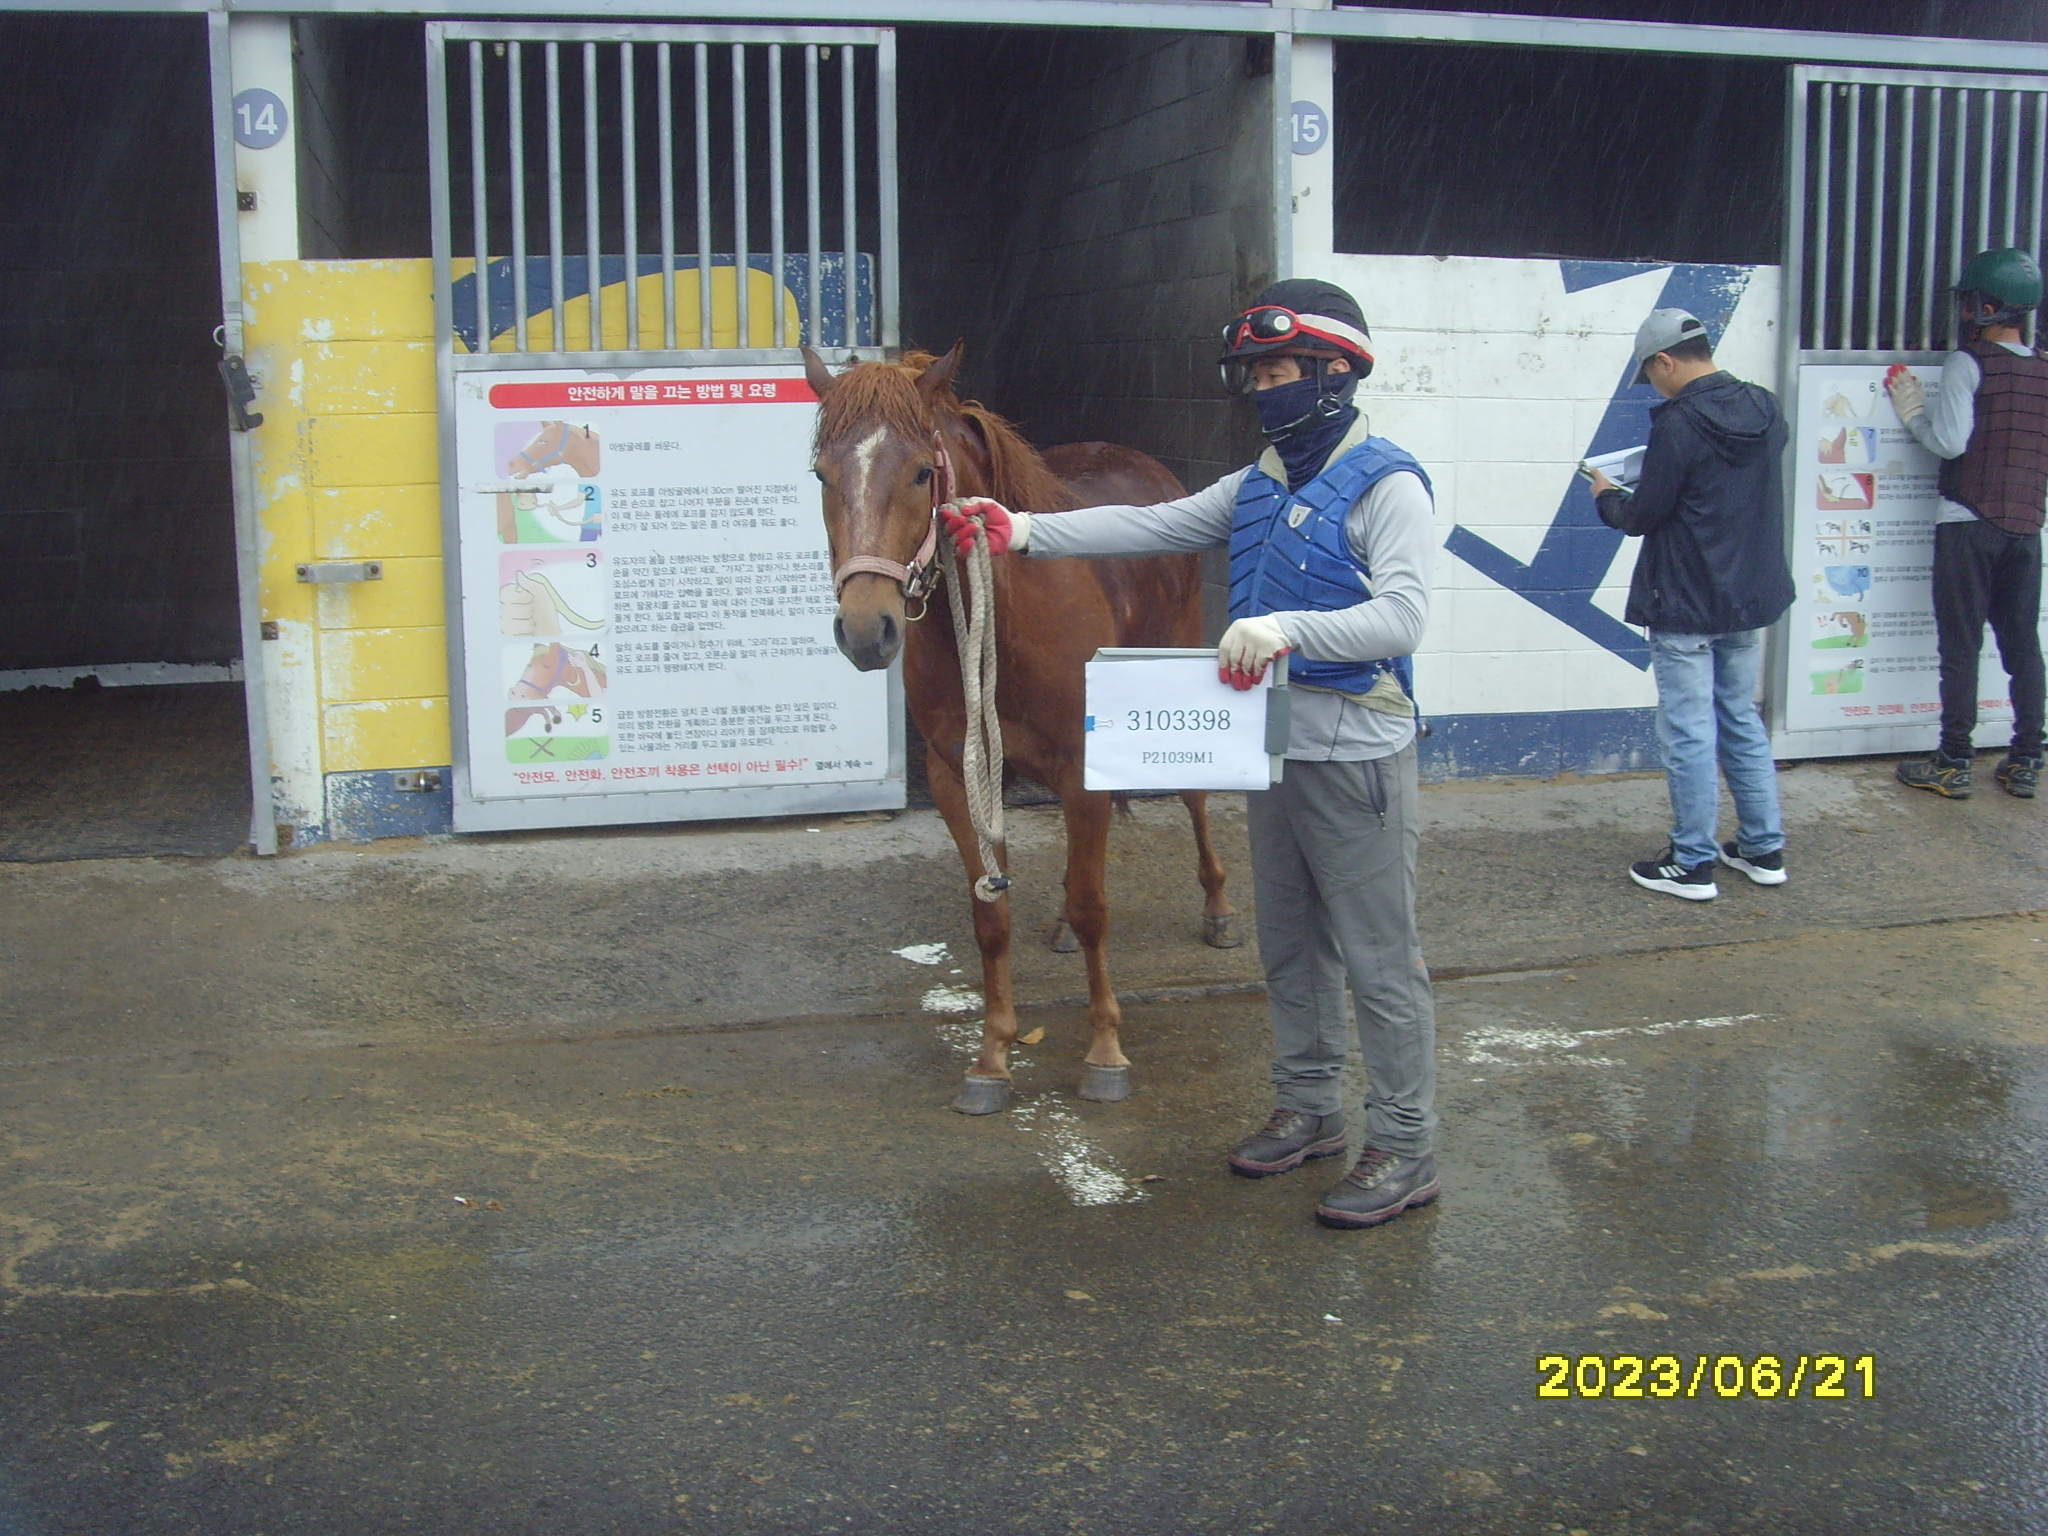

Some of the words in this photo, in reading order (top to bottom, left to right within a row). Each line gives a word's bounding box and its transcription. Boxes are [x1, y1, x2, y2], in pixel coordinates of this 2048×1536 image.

[237, 103, 278, 135] 14
[1290, 113, 1320, 143] 15
[567, 385, 624, 401] 안전하게
[629, 384, 658, 400] 말을
[662, 385, 691, 399] 끄는
[696, 383, 724, 398] 방법
[729, 383, 743, 397] 및
[748, 383, 776, 398] 요령
[1869, 382, 1876, 392] 6
[582, 424, 590, 438] 1
[1868, 428, 1874, 439] 7
[608, 441, 651, 451] 마방굴레를
[1866, 475, 1872, 485] 8
[584, 486, 595, 500] 2
[610, 488, 627, 497] 유도
[630, 487, 655, 496] 로프를
[658, 486, 708, 496] 마방굴레에서
[710, 486, 734, 494] 30cm
[736, 485, 762, 494] 떨어진
[764, 484, 796, 493] 지점에서
[610, 499, 627, 509] 오른
[630, 499, 655, 508] 손으로
[658, 498, 675, 507] 잡고
[705, 496, 730, 506] 부분을
[734, 496, 759, 505] 왼손에
[761, 496, 778, 504] 모아
[610, 511, 620, 519] 이
[622, 511, 631, 520] 때
[634, 510, 650, 519] 왼손
[681, 508, 706, 518] 로프를
[709, 508, 726, 517] 감지
[728, 507, 754, 517] 않도록
[756, 506, 775, 516] 한다.
[610, 522, 637, 531] 순치가
[639, 522, 648, 531] 잘
[650, 521, 668, 530] 되어
[670, 521, 687, 529] 있는
[689, 519, 707, 529] 말은
[720, 519, 729, 528] 더
[732, 518, 757, 528] 여유를
[586, 552, 597, 568] 3
[612, 556, 645, 565] 유도자의
[668, 554, 709, 564] 진행하려는
[712, 553, 745, 562] 방향으로
[748, 552, 773, 561] 향하고
[776, 551, 792, 560] 유도
[795, 550, 819, 559] 로프를
[612, 567, 629, 577] 손을
[631, 567, 649, 576] 약간
[756, 562, 789, 572] 말하거나
[1857, 568, 1868, 578] 10
[612, 578, 655, 588] 조심스럽게
[657, 578, 674, 587] 걷기
[715, 575, 732, 585] 말이
[734, 575, 751, 584] 따라
[754, 574, 771, 584] 걷기
[773, 573, 806, 583] 시작하면
[613, 590, 638, 599] 로프에
[641, 589, 674, 598] 가해지는
[705, 587, 732, 596] 줄인다.
[734, 586, 752, 595] 말이
[754, 584, 787, 594] 유도자를
[789, 584, 806, 593] 끌고
[699, 599, 708, 608] 말
[710, 598, 727, 607] 목에
[730, 597, 747, 606] 대어
[749, 596, 774, 606] 간격을
[776, 595, 802, 605] 유지한
[804, 595, 821, 603] 채로
[633, 612, 653, 621] 한다.
[683, 610, 708, 619] 때마다
[787, 607, 804, 616] 말이
[614, 624, 647, 634] 잡으려고
[650, 623, 666, 632] 하는
[588, 644, 600, 658] 4
[614, 642, 632, 652] 말의
[634, 641, 659, 651] 속도를
[662, 640, 696, 650] 줄이거나
[697, 639, 723, 649] 멈추기
[615, 653, 632, 662] 유도
[635, 652, 659, 662] 로프를
[662, 652, 679, 661] 줄여
[704, 649, 736, 660] 오른손을
[739, 649, 756, 658] 말의
[770, 647, 802, 657] 근처까지
[615, 665, 632, 674] 유도
[635, 664, 660, 673] 로프가
[706, 661, 726, 670] 한다.
[592, 708, 602, 722] 5
[616, 710, 634, 719] 급한
[636, 708, 678, 718] 방향전환은
[680, 707, 697, 716] 덩치
[700, 706, 708, 715] 큰
[730, 704, 771, 714] 동물에게는
[811, 701, 839, 710] 일이다.
[617, 721, 634, 730] 미리
[636, 720, 654, 730] 방향
[656, 718, 681, 728] 전환을
[747, 714, 771, 725] 공간을
[774, 714, 791, 723] 두고
[793, 713, 810, 722] 크게
[1126, 710, 1231, 731] 3103398
[618, 732, 635, 742] 또한
[637, 731, 662, 740] 바닥에
[747, 726, 756, 736] 등
[618, 743, 635, 752] 있는
[637, 741, 670, 752] 사물과는
[673, 740, 698, 750] 거리를
[700, 739, 718, 748] 두고
[720, 738, 736, 748] 말을
[739, 736, 774, 747] 유도한다.
[815, 760, 840, 770] 옆에서
[844, 759, 860, 768] 계속
[1142, 752, 1214, 764] P21039M1
[610, 765, 659, 779] 안전조끼
[664, 763, 701, 777] 착용은
[705, 761, 741, 774] 선택이
[745, 760, 770, 773] 아닌
